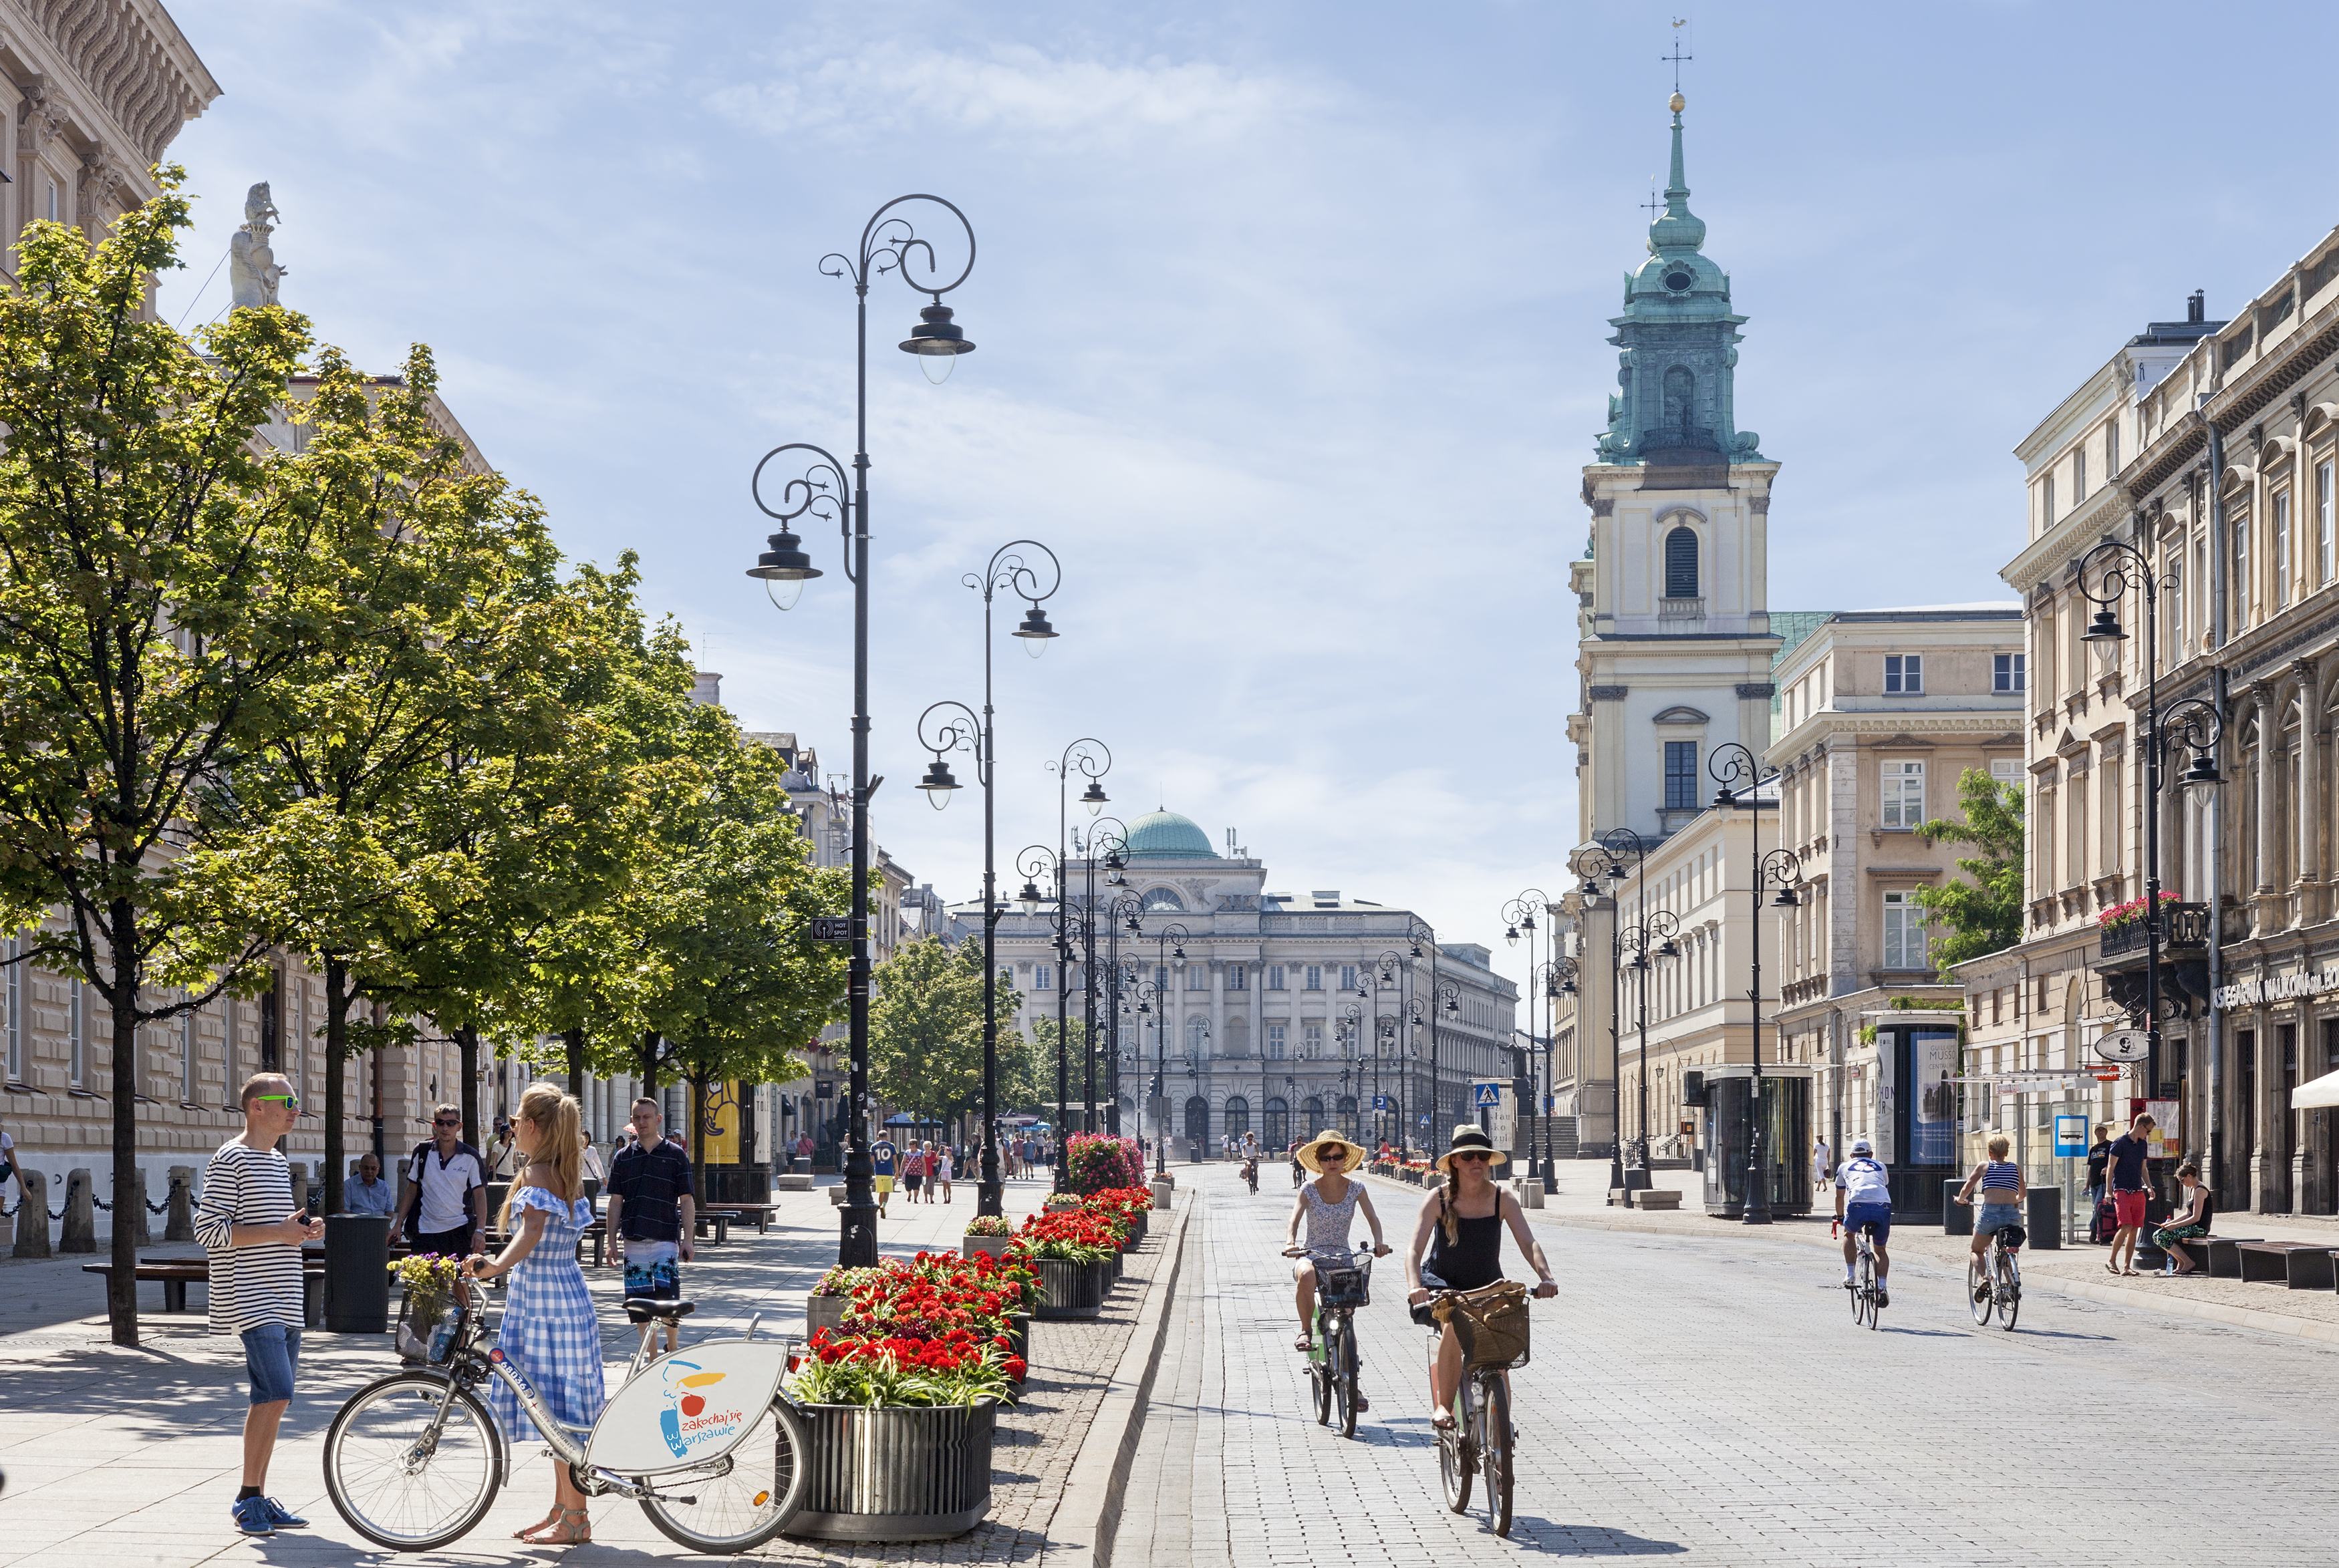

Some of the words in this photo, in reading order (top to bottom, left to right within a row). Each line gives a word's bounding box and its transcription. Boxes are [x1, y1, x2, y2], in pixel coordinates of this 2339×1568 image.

[2213, 981, 2263, 1011] KSIĘGARNIA
[2264, 972, 2311, 1001] NAUKOWA
[2324, 966, 2339, 991] BO
[2102, 1032, 2131, 1044] Kawiarnia
[1930, 1050, 1955, 1060] MUSSO
[875, 1148, 891, 1160] 10
[501, 1362, 526, 1390] 68036
[539, 1410, 551, 1423] CITY
[550, 1424, 577, 1451] SECURITY
[682, 1410, 729, 1431] zakochaj
[730, 1410, 742, 1423] się
